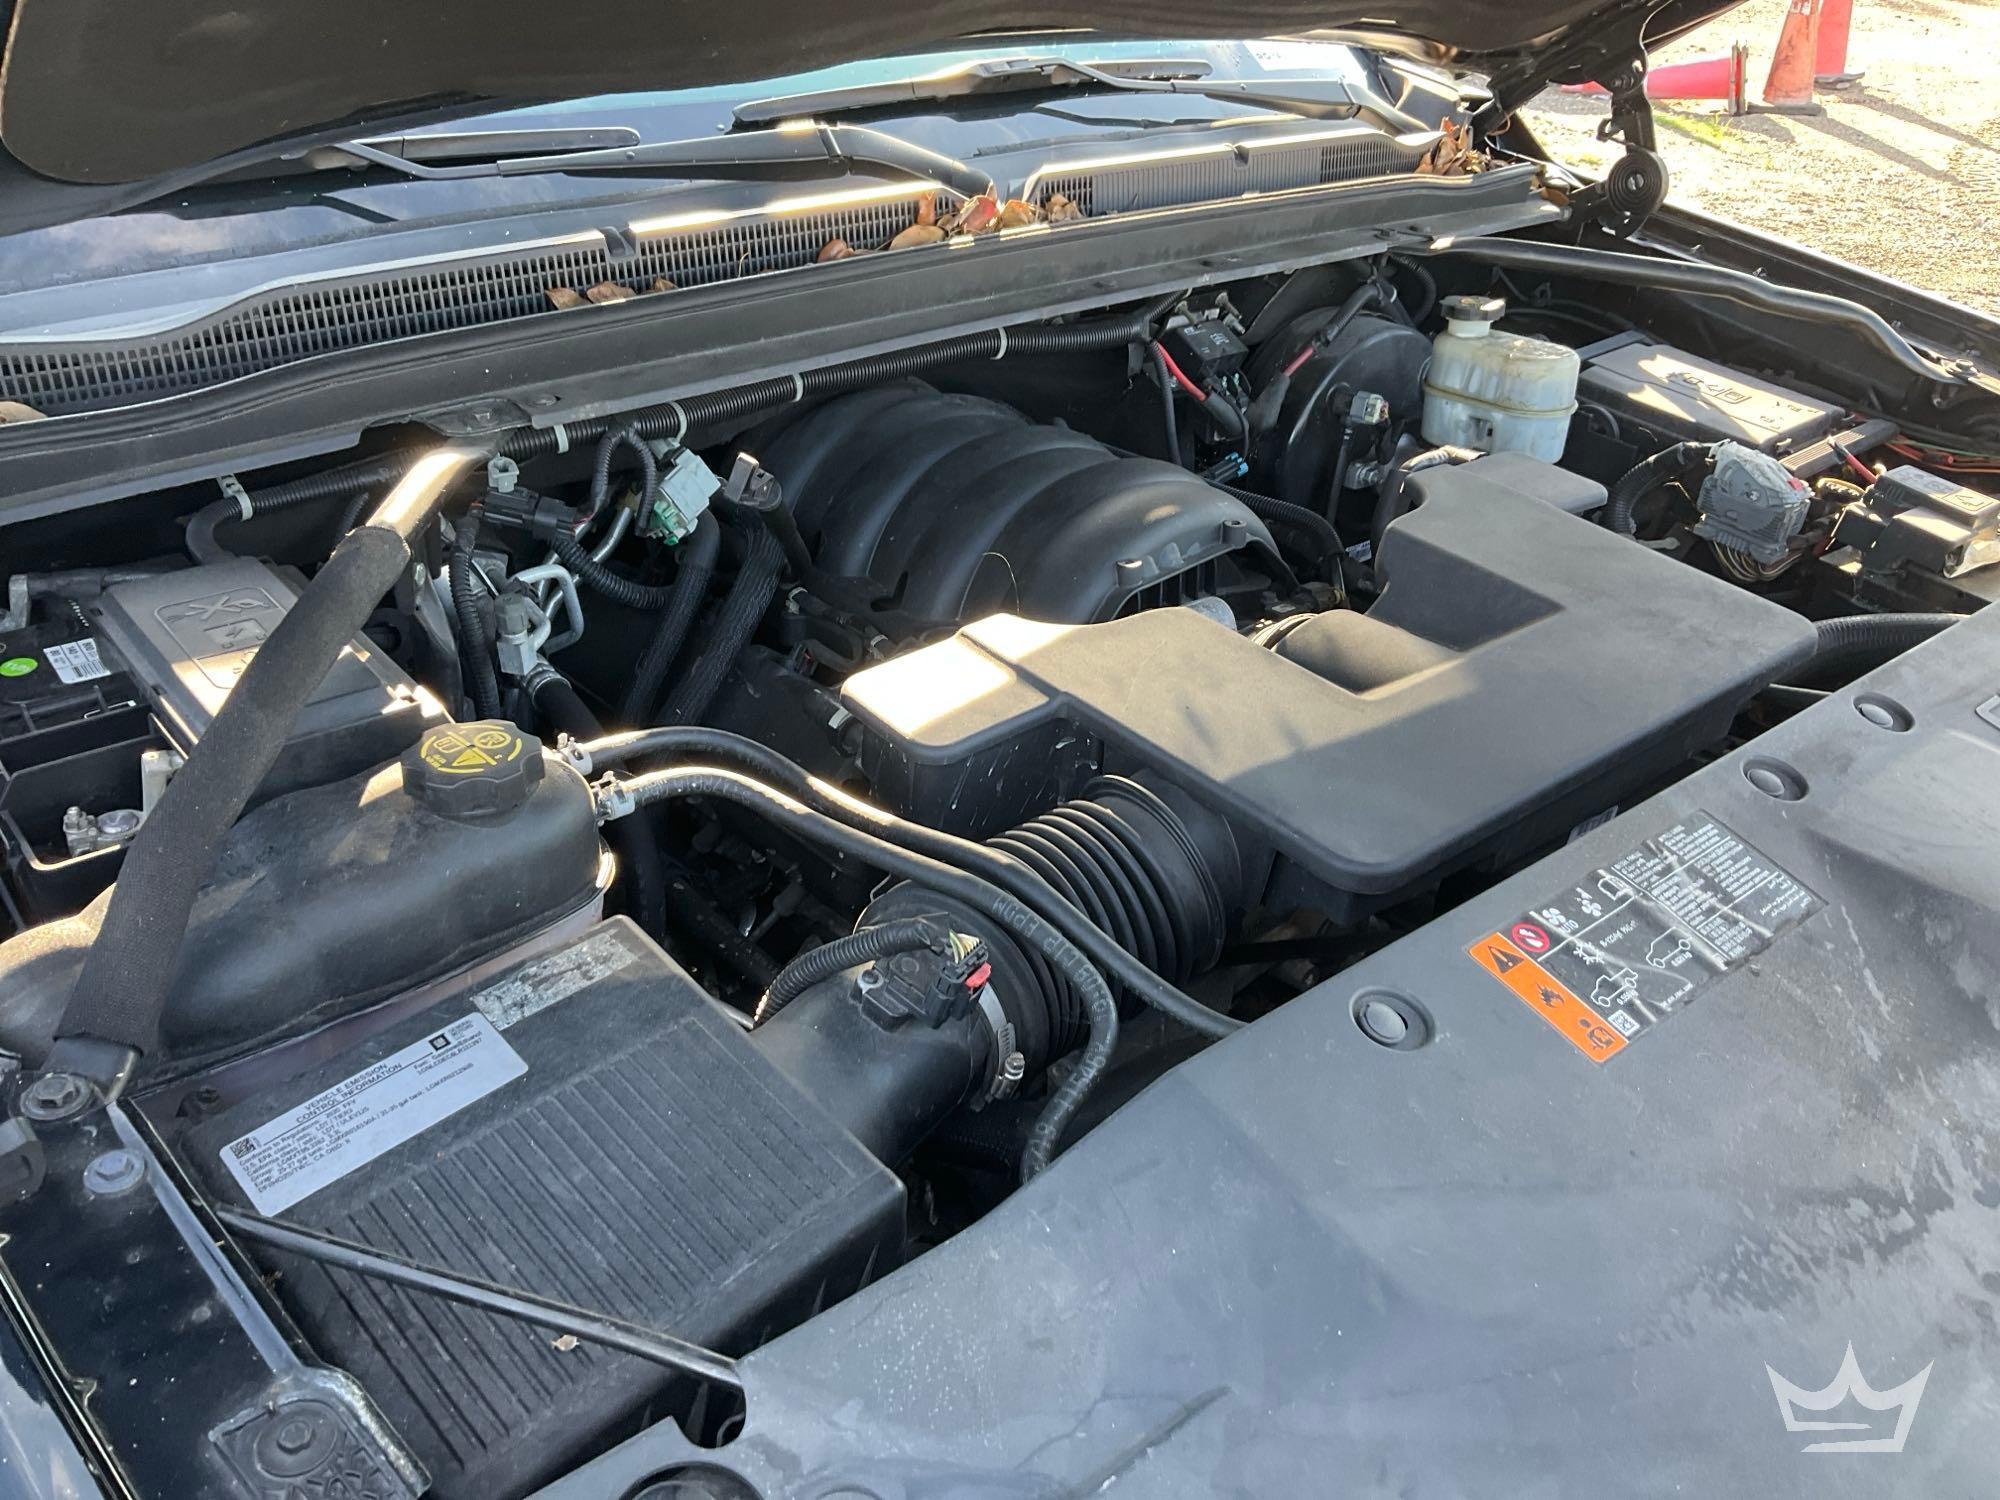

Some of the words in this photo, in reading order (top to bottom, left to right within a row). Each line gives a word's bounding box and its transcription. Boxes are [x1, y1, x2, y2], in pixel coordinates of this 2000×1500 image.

[296, 1098, 340, 1123] CONTROL
[341, 1064, 403, 1099] INFORMATION
[306, 1088, 344, 1110] VEHICLE
[344, 1064, 387, 1089] EMISSION
